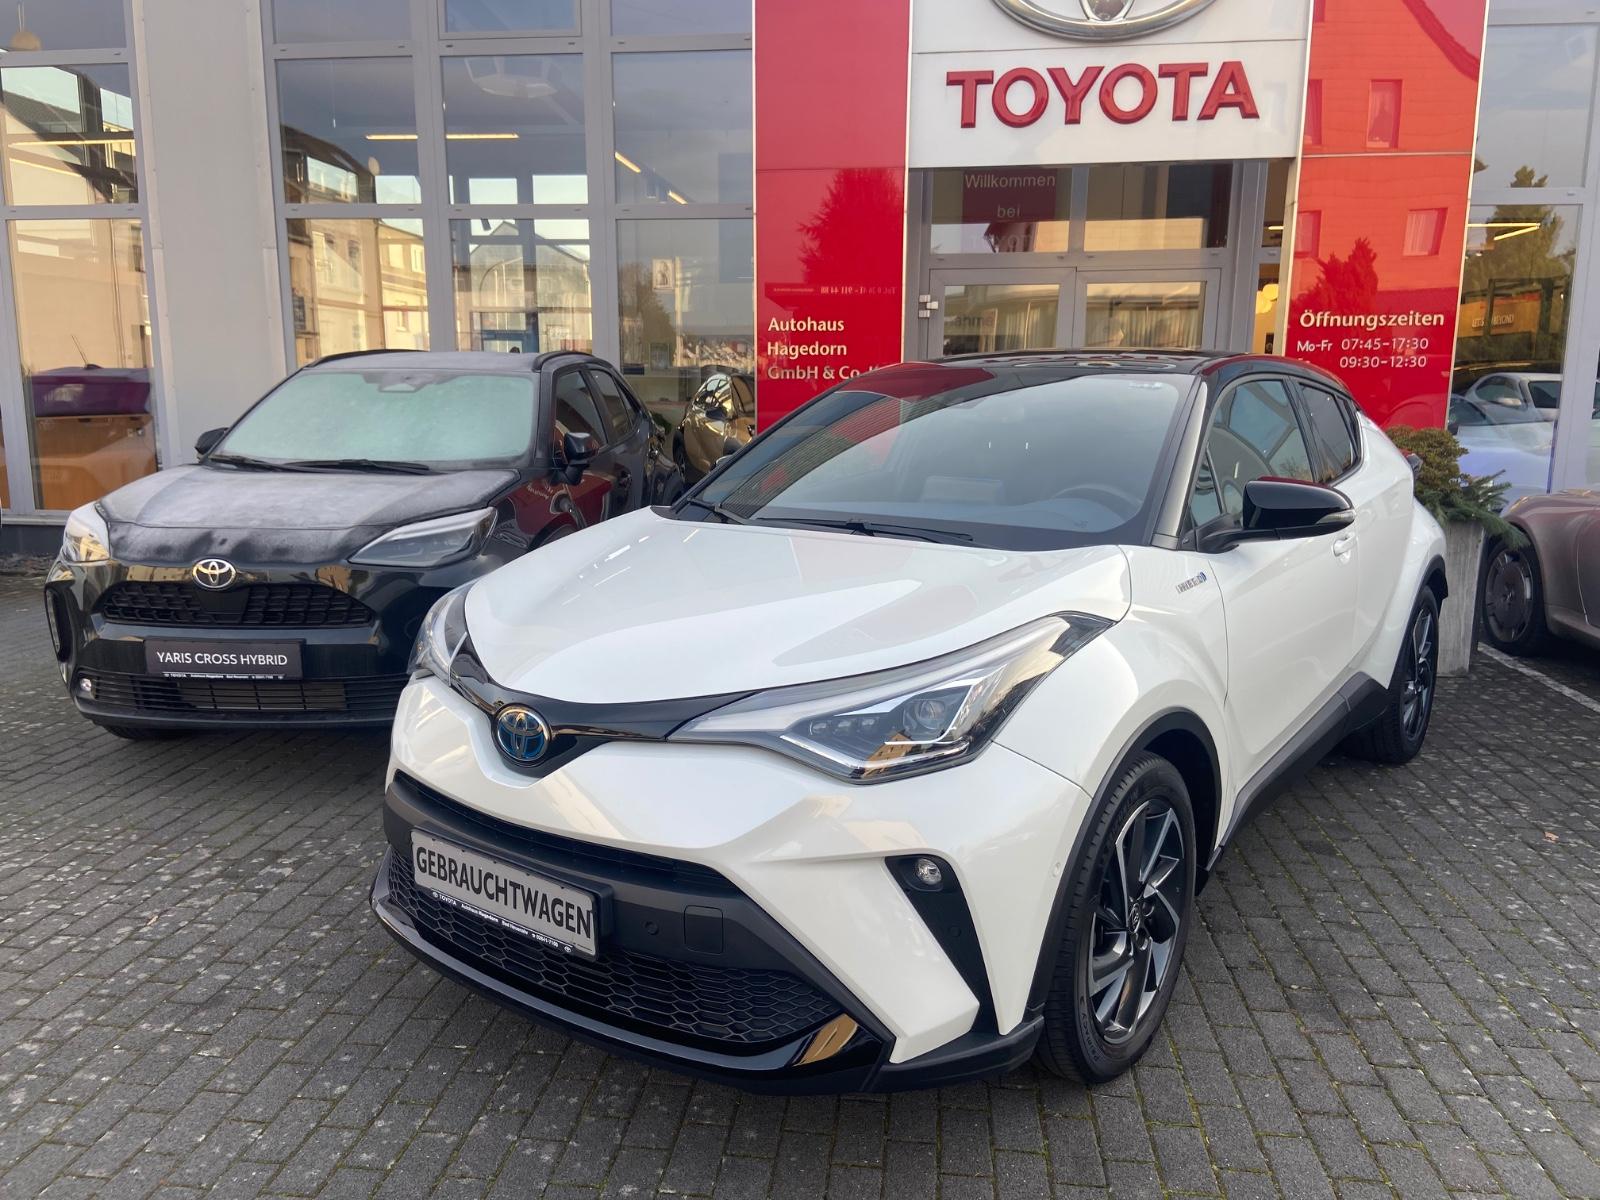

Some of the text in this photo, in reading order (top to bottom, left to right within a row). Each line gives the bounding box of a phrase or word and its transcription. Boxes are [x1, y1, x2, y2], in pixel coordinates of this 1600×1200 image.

[946, 61, 1260, 129] TOYOTA
[965, 173, 1056, 189] Willkommen
[997, 204, 1021, 218] bei
[768, 316, 845, 332] Autohaus
[1300, 309, 1445, 331] Öffnungszeiten
[767, 341, 847, 360] Hagedorn
[1297, 337, 1429, 352] Mo-Fr 07:45-17:30
[1339, 355, 1427, 369] 09:30-12:30
[767, 364, 819, 380] GmbH
[822, 365, 835, 380] &
[157, 651, 288, 666] YARIS CROSS HYBRID
[416, 846, 592, 939] GEBRAUCHTWAGEN
[440, 894, 457, 906] TOYOTA
